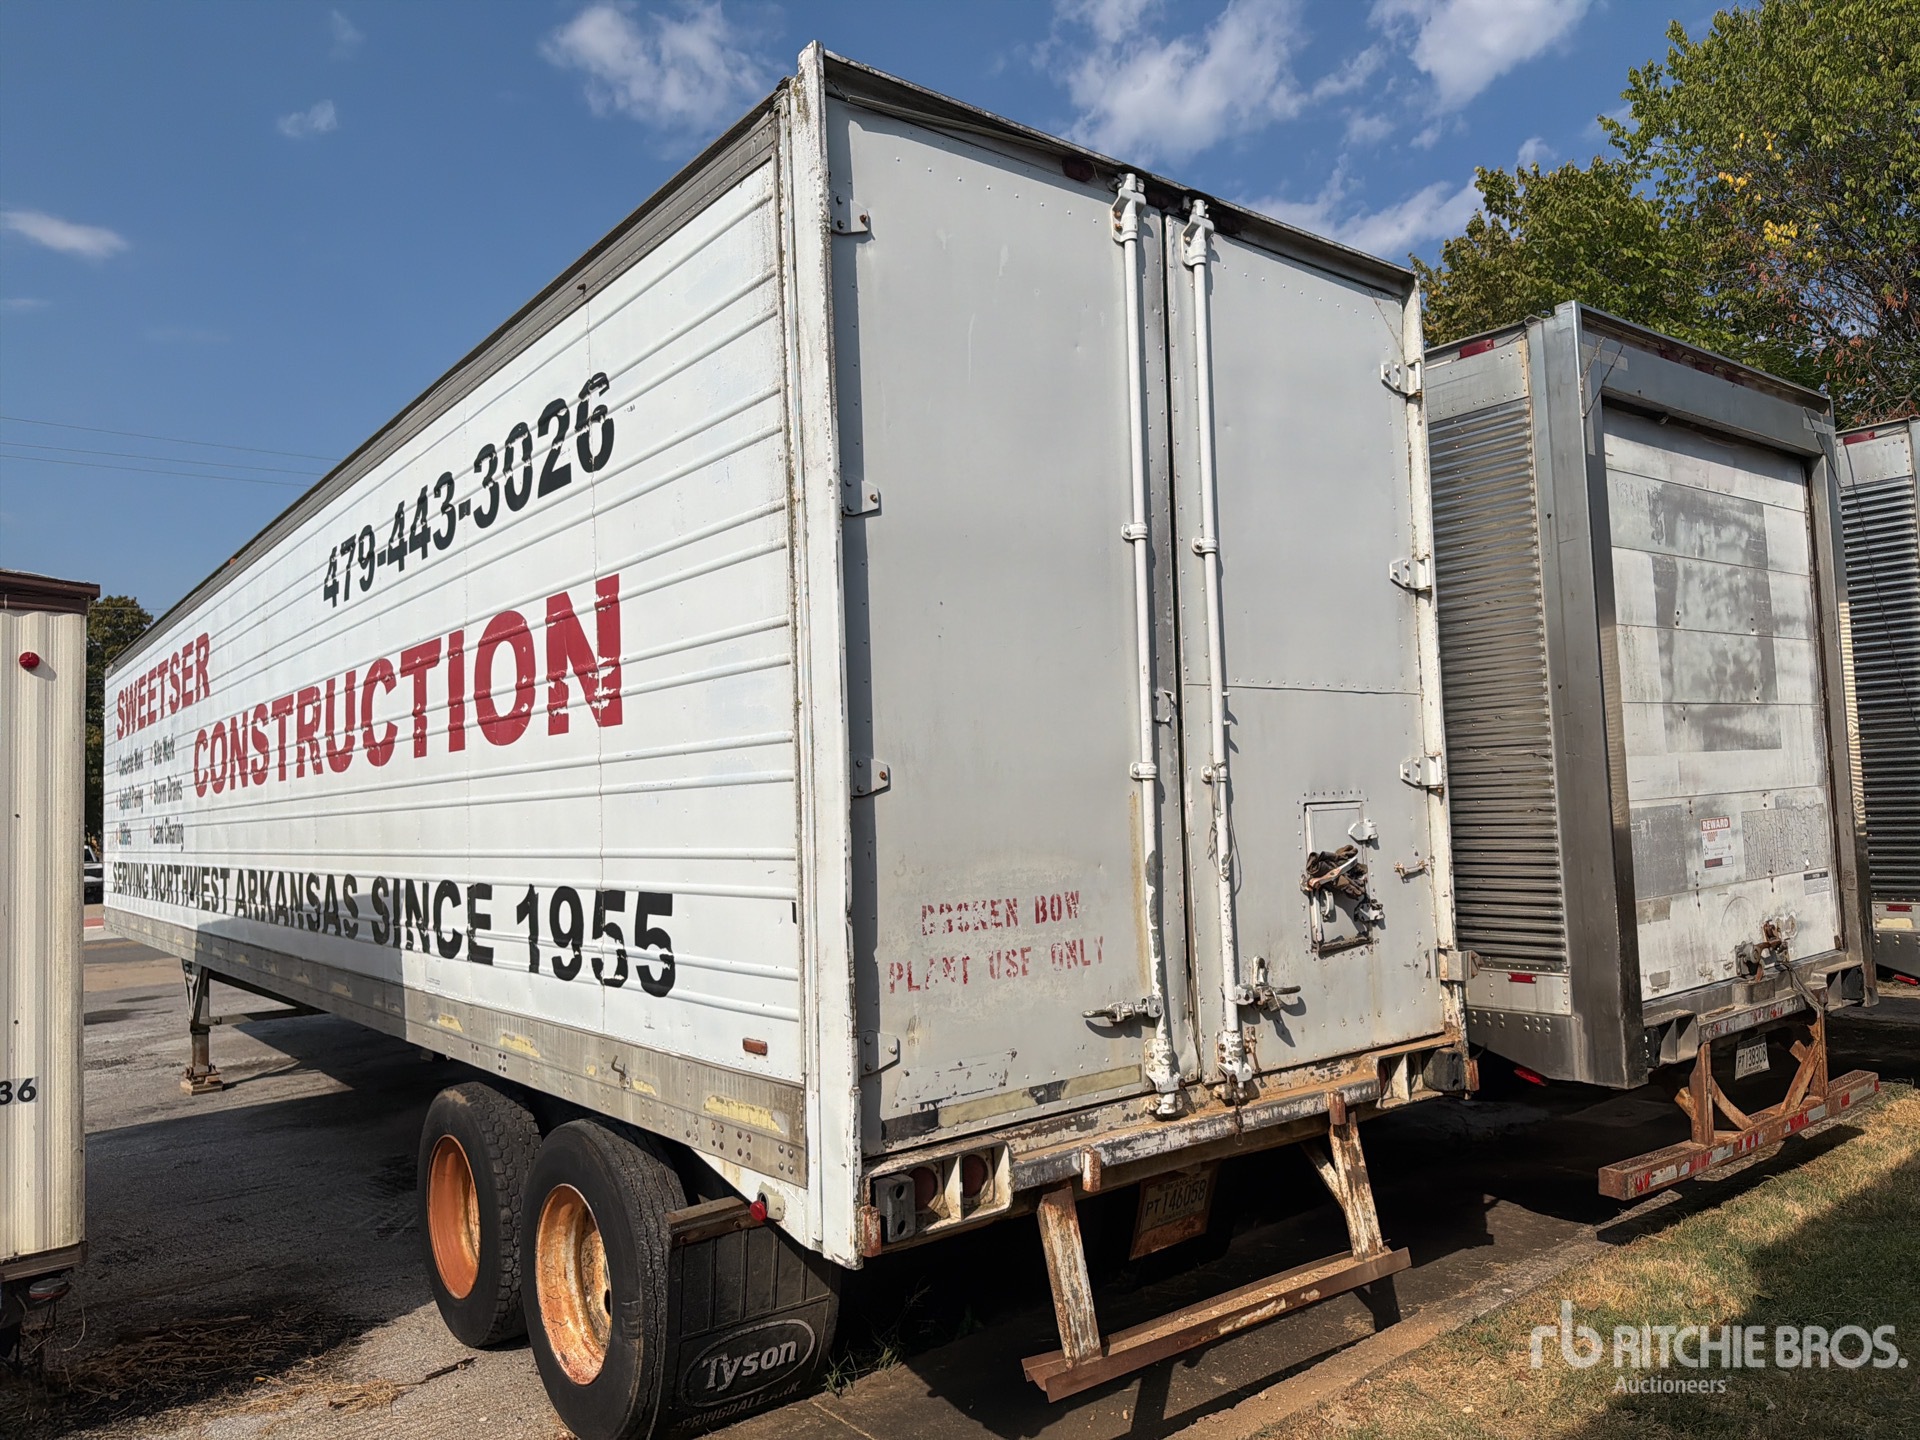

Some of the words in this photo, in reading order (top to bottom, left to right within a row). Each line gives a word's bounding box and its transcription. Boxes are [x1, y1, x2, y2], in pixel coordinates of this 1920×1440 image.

[323, 372, 614, 608] 479-443-3026
[117, 633, 210, 740] SWEETSER
[194, 573, 622, 797] CONSTRUCTION
[1702, 819, 1729, 830] REWARD
[112, 862, 149, 899] SERVING
[151, 863, 230, 914] NORTHWEST
[234, 869, 359, 937] ARKANSAS
[371, 876, 494, 966] SINCE
[516, 883, 676, 998] 1955
[1034, 890, 1080, 924] BOW
[889, 955, 970, 994] PLANT
[987, 946, 1032, 980] USE
[1051, 935, 1104, 972] ONLY
[701, 1340, 798, 1392] Tyson
